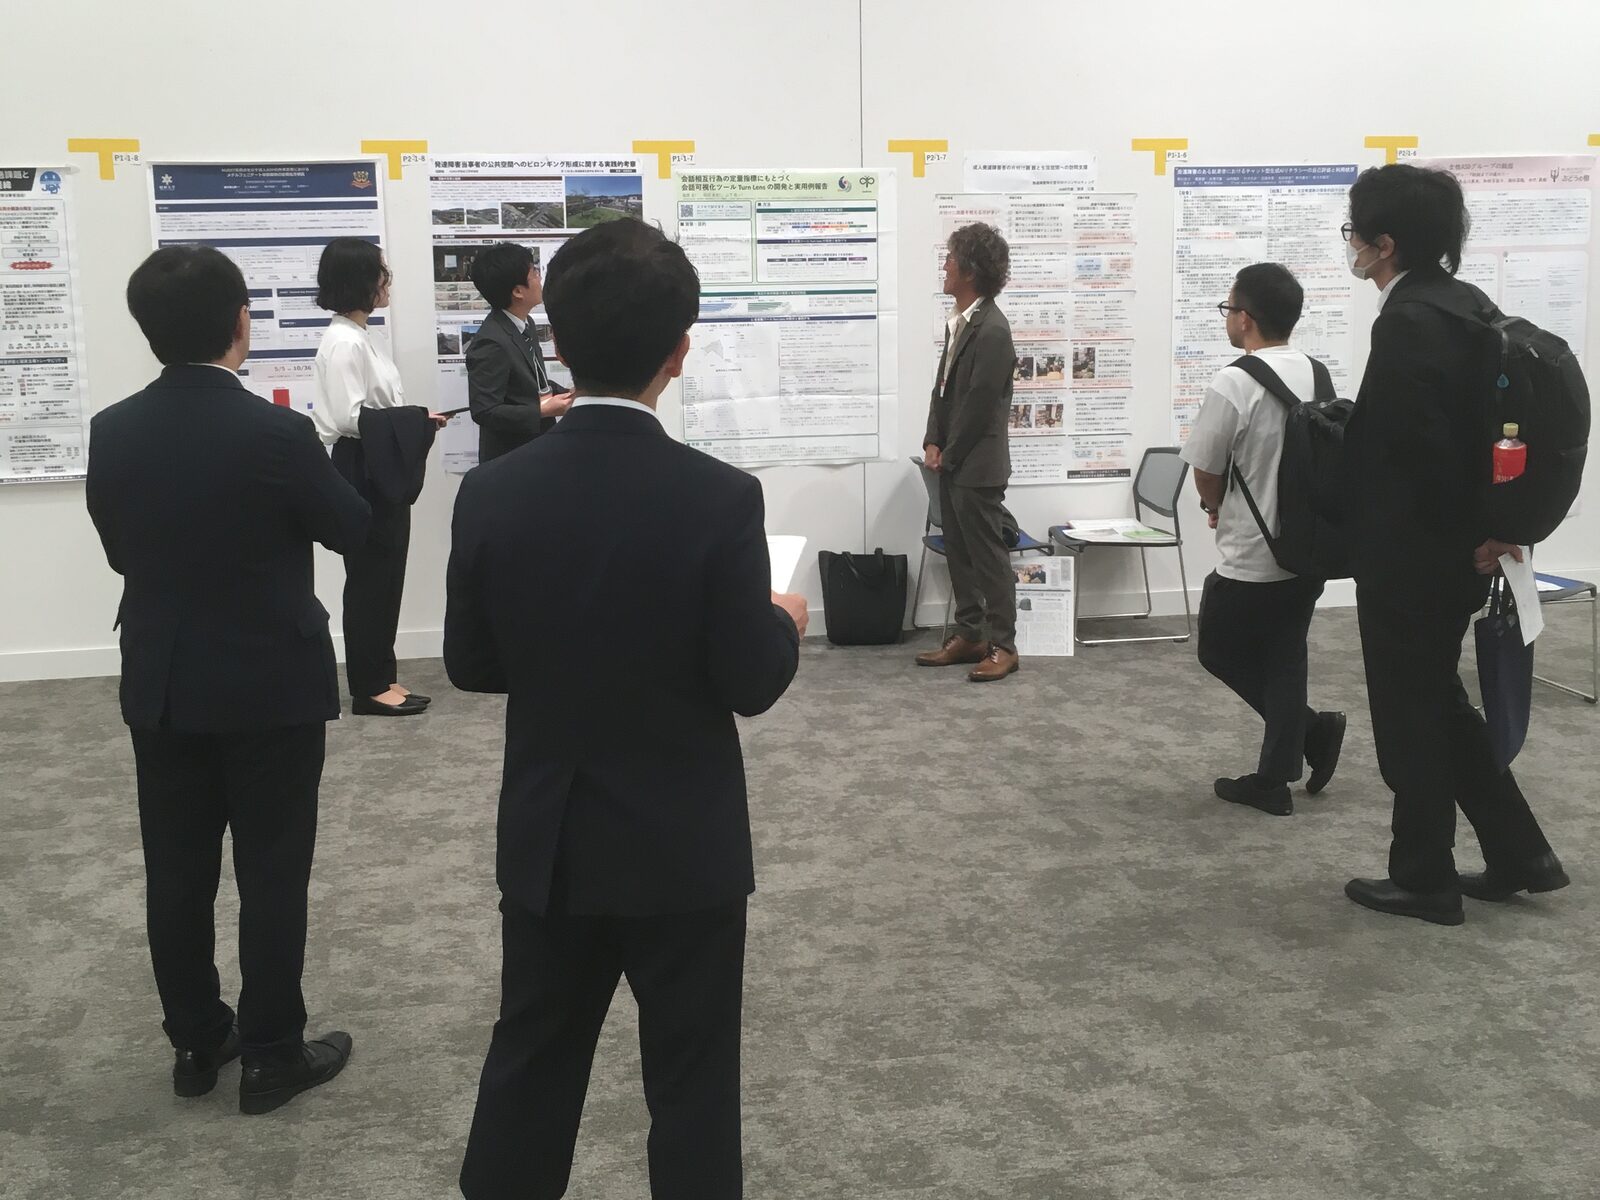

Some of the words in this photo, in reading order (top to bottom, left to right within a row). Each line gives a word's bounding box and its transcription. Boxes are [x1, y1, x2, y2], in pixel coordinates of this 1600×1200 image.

[681, 183, 736, 192] 会話可視化ツール
